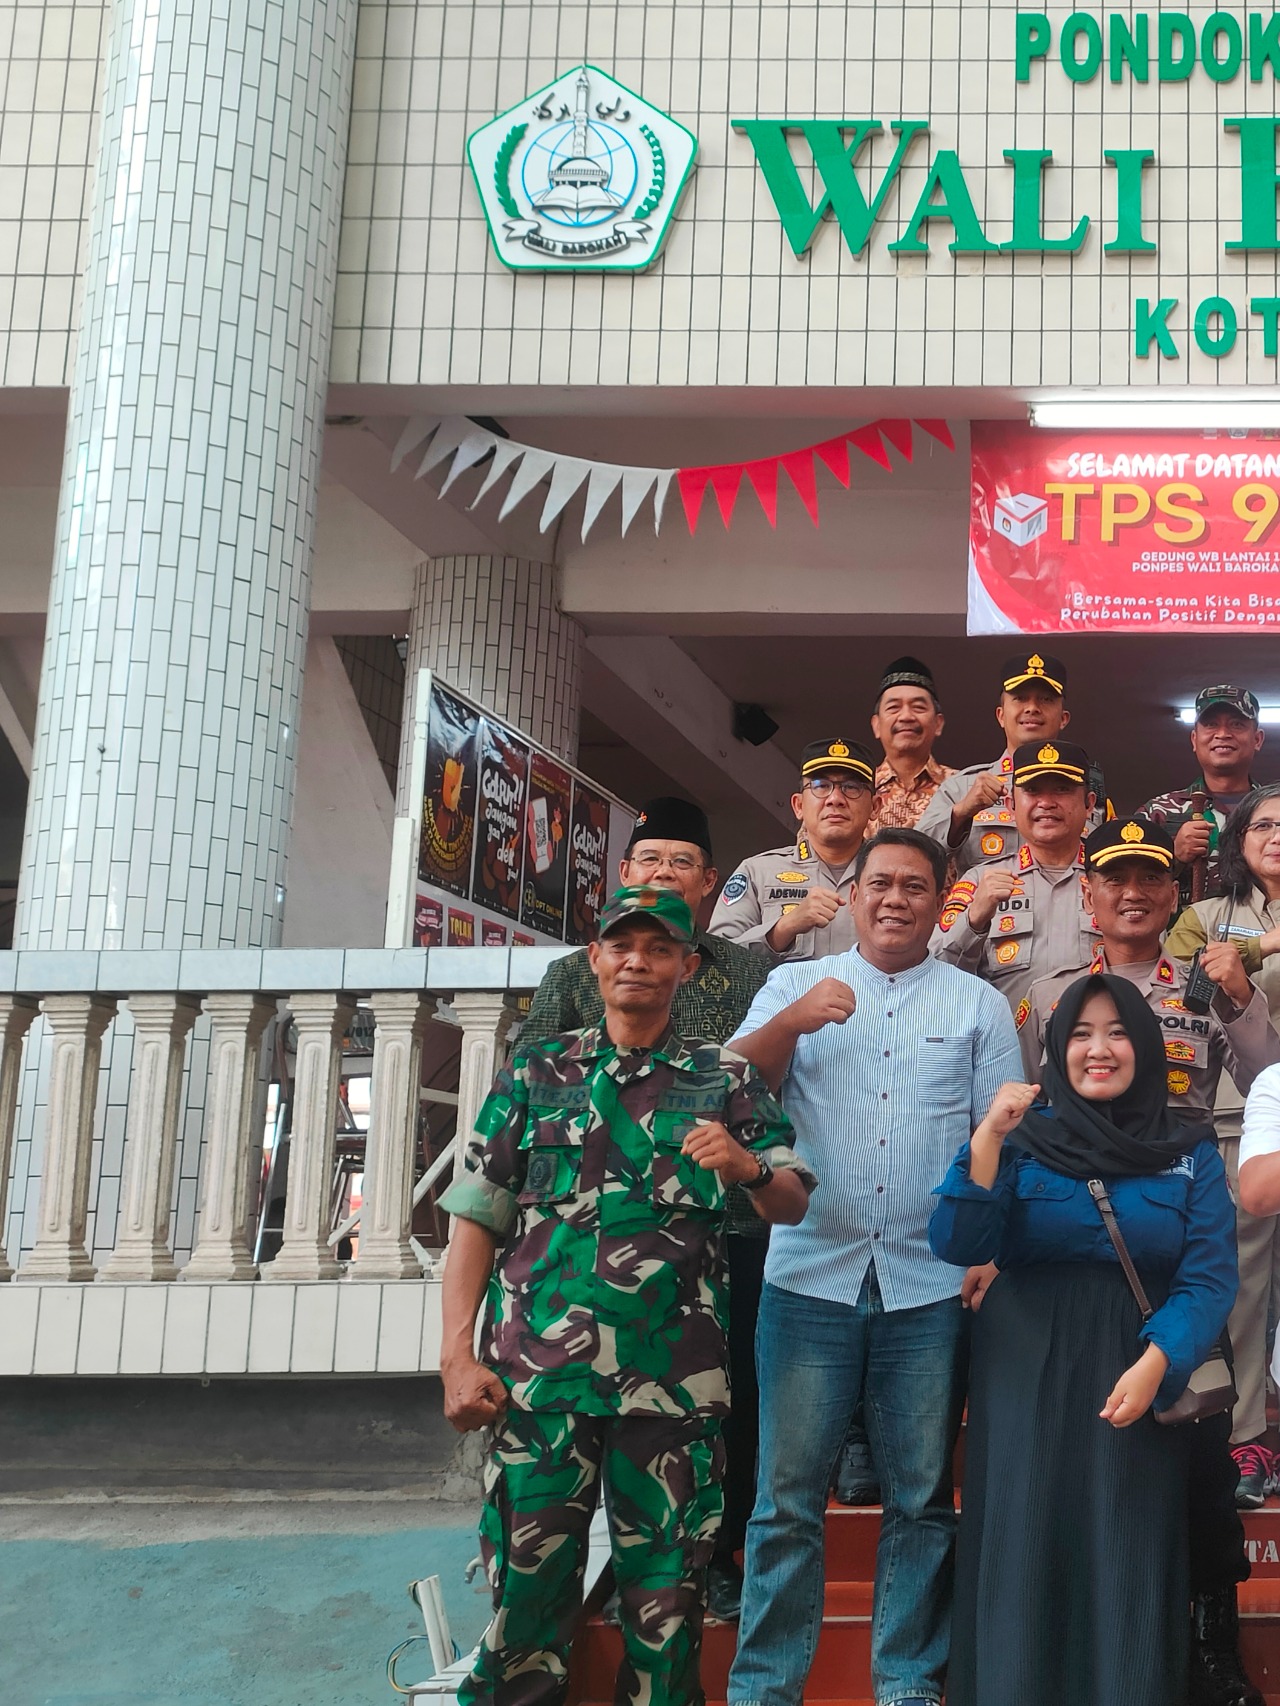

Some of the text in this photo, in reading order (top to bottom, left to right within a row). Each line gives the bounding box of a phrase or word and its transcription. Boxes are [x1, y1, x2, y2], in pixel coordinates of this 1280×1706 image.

[731, 119, 1157, 261] WALI
[527, 232, 623, 255] WALI BAROKAH
[1067, 453, 1190, 479] SELAMAT
[1045, 482, 1204, 544] TPS
[1141, 551, 1280, 562] GEDUNG WB LANTAI 1
[1132, 562, 1185, 573] PONPES
[1187, 562, 1222, 573] WALI
[1205, 593, 1241, 607] Kita
[1060, 607, 1156, 621] Perubahan
[1159, 608, 1218, 622] Positif
[450, 916, 473, 940] TOLAK
[667, 1094, 697, 1108] TNI
